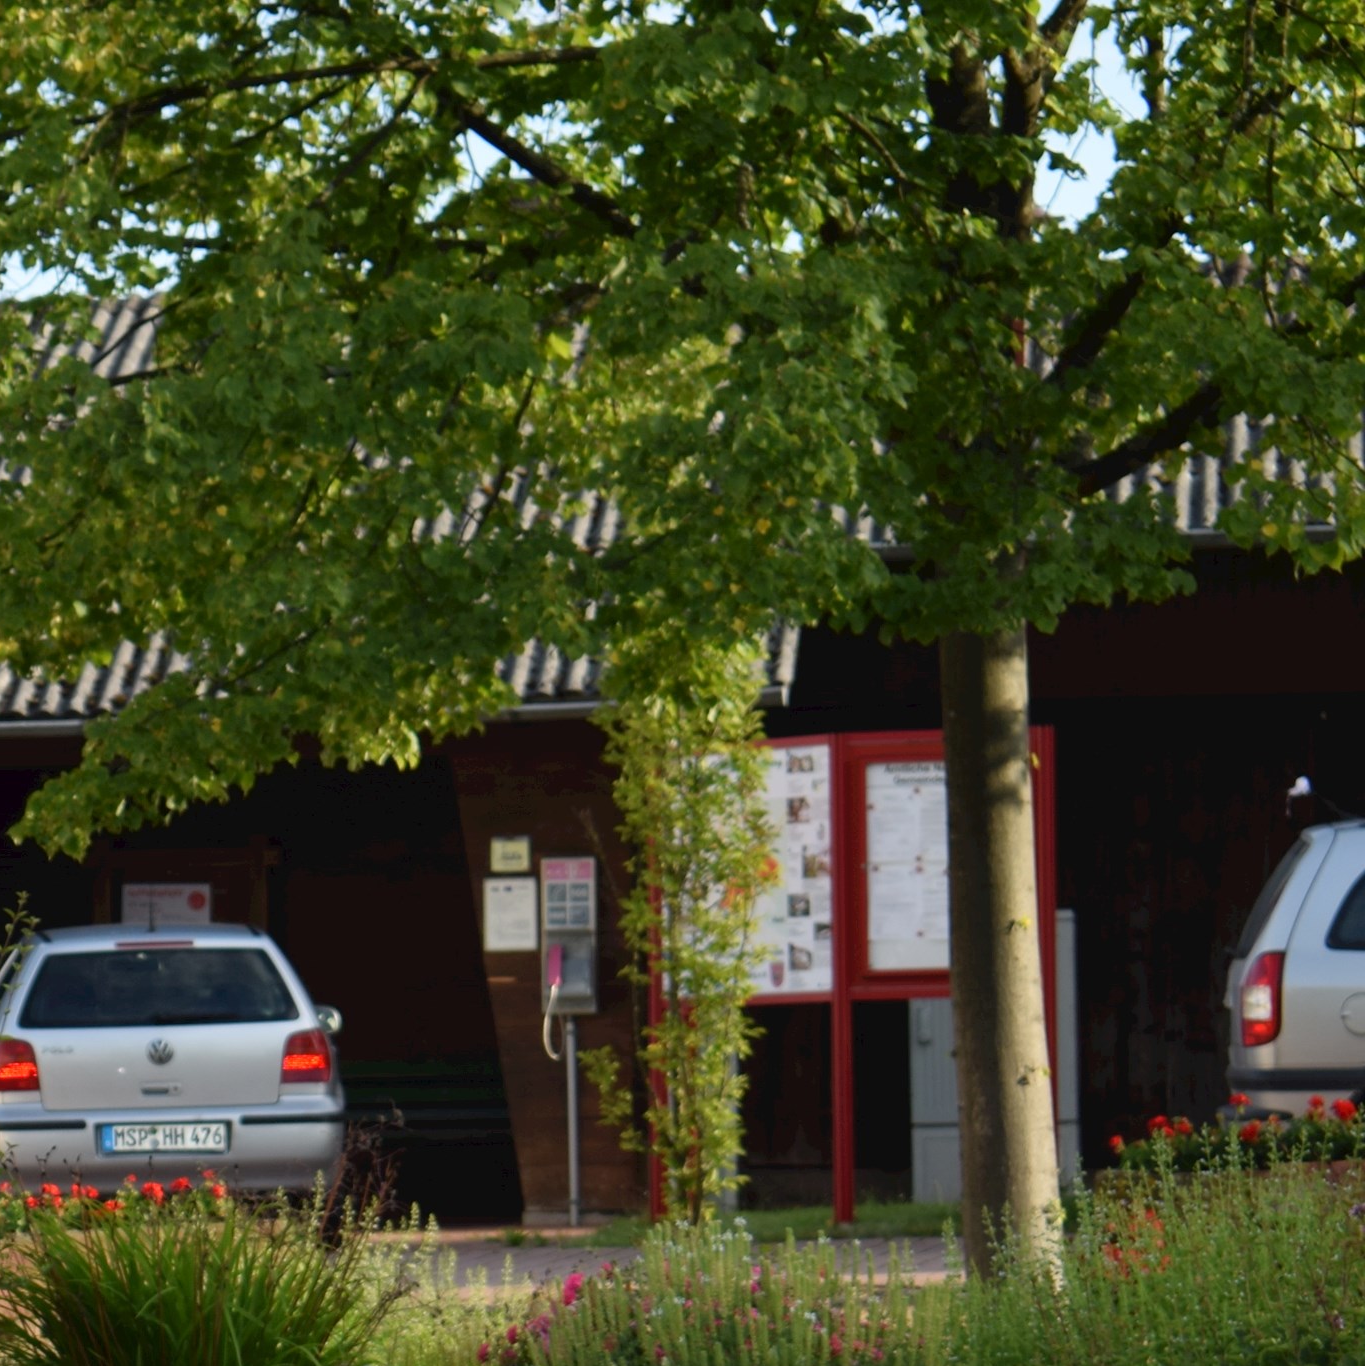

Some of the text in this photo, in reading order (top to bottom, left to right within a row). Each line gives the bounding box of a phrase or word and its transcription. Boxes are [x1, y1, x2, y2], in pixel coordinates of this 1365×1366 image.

[114, 1127, 222, 1147] MSP HH 476
